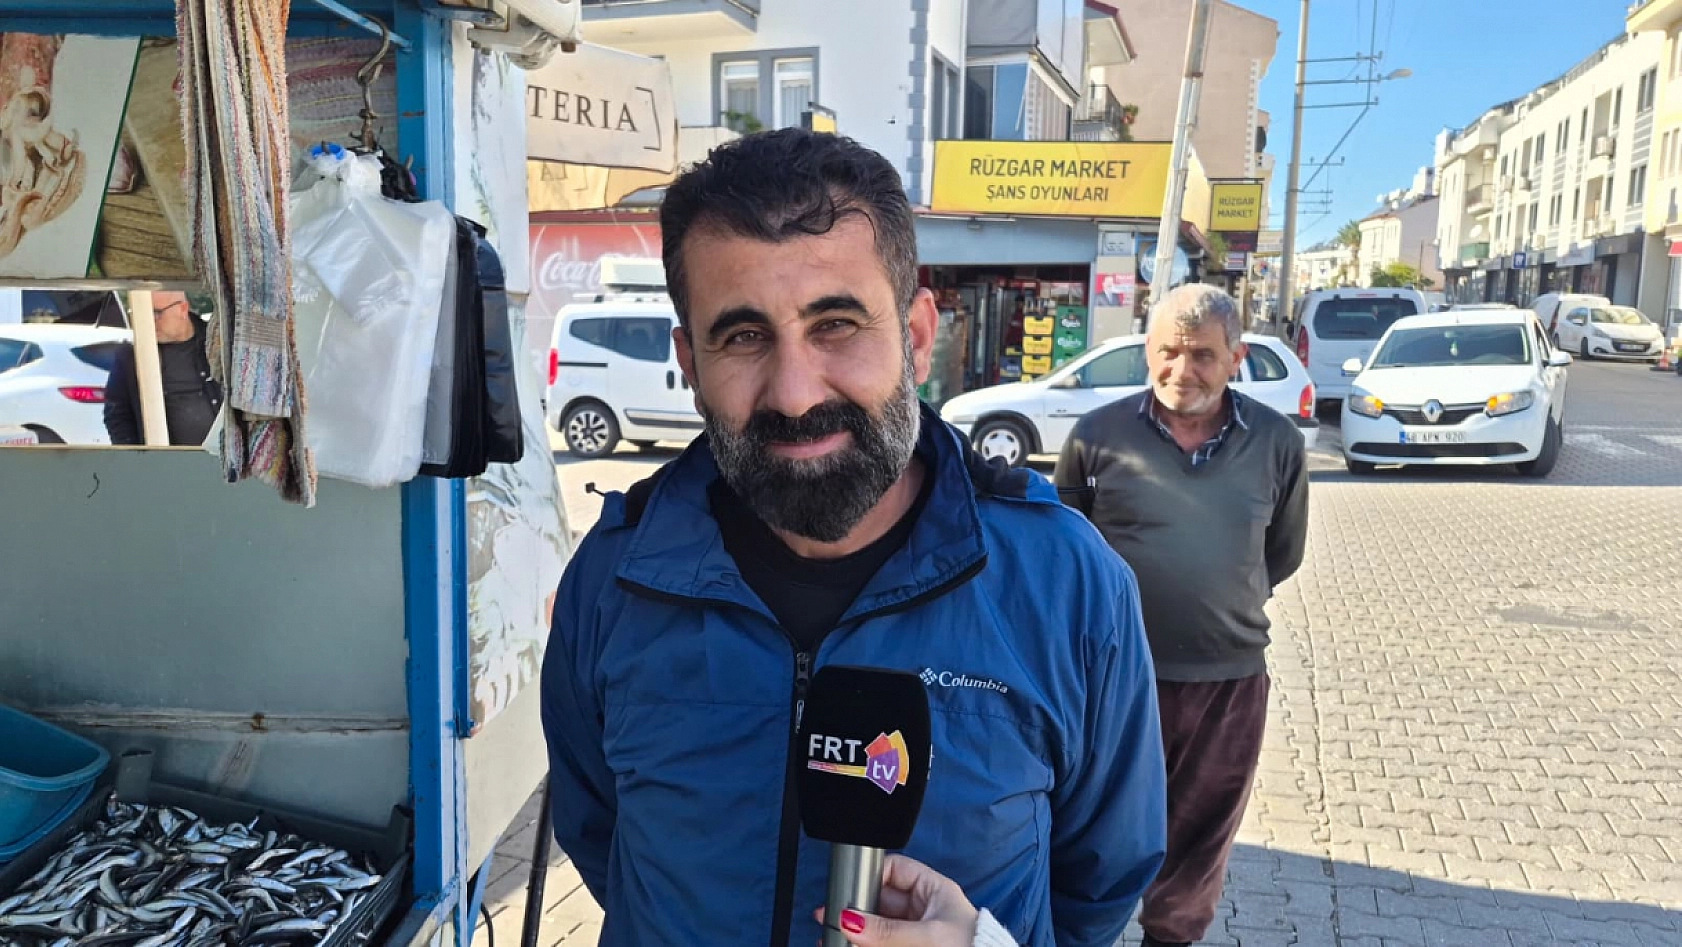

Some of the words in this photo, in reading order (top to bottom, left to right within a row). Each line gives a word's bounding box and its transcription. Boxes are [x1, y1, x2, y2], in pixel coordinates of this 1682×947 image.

[970, 154, 1044, 178] RÜZGAR
[1050, 160, 1131, 178] MARKET
[986, 185, 1026, 202] ŞANS
[1031, 186, 1109, 202] OYUNLARI
[1217, 209, 1253, 218] MARKET
[938, 671, 1008, 694] Columbia
[808, 733, 862, 763] FRT
[872, 760, 896, 780] tv
